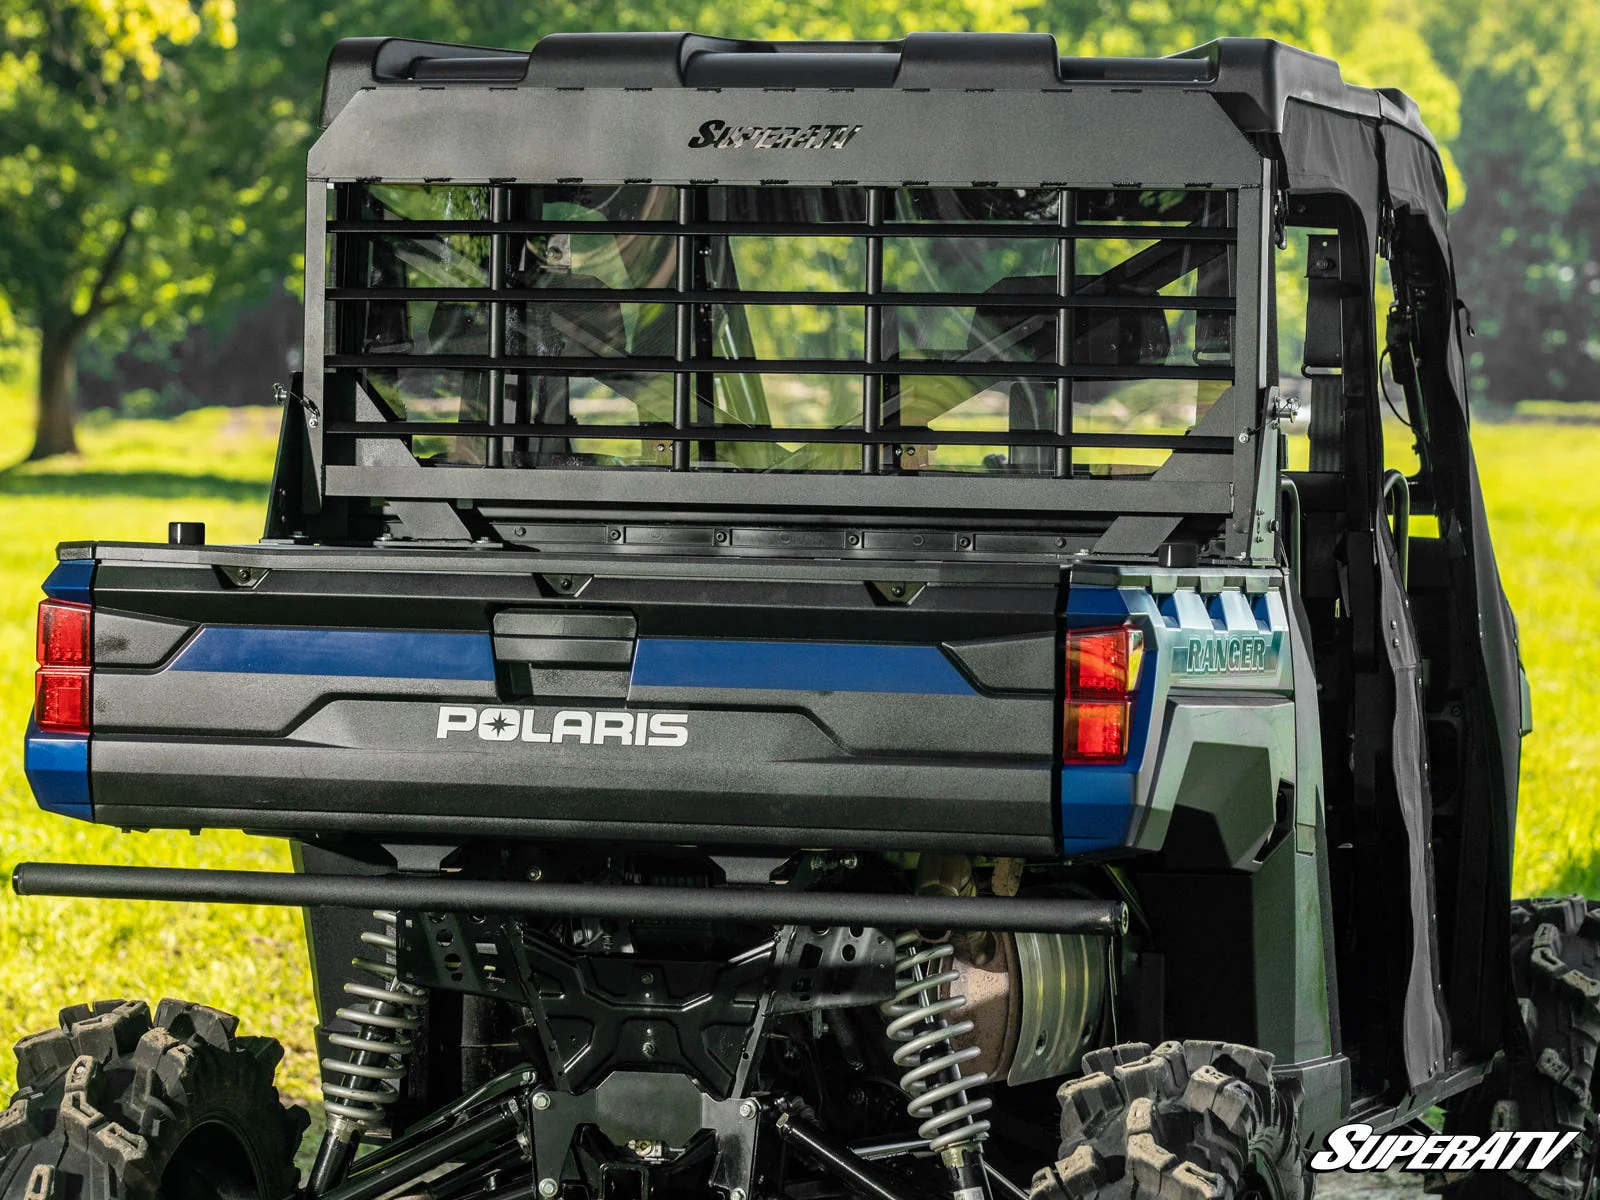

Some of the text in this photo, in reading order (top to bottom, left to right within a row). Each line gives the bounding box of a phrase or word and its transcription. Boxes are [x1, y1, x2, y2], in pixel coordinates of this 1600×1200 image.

[688, 119, 863, 149] SUPERATV
[1187, 636, 1265, 673] RANGER
[436, 706, 689, 747] POLARIS
